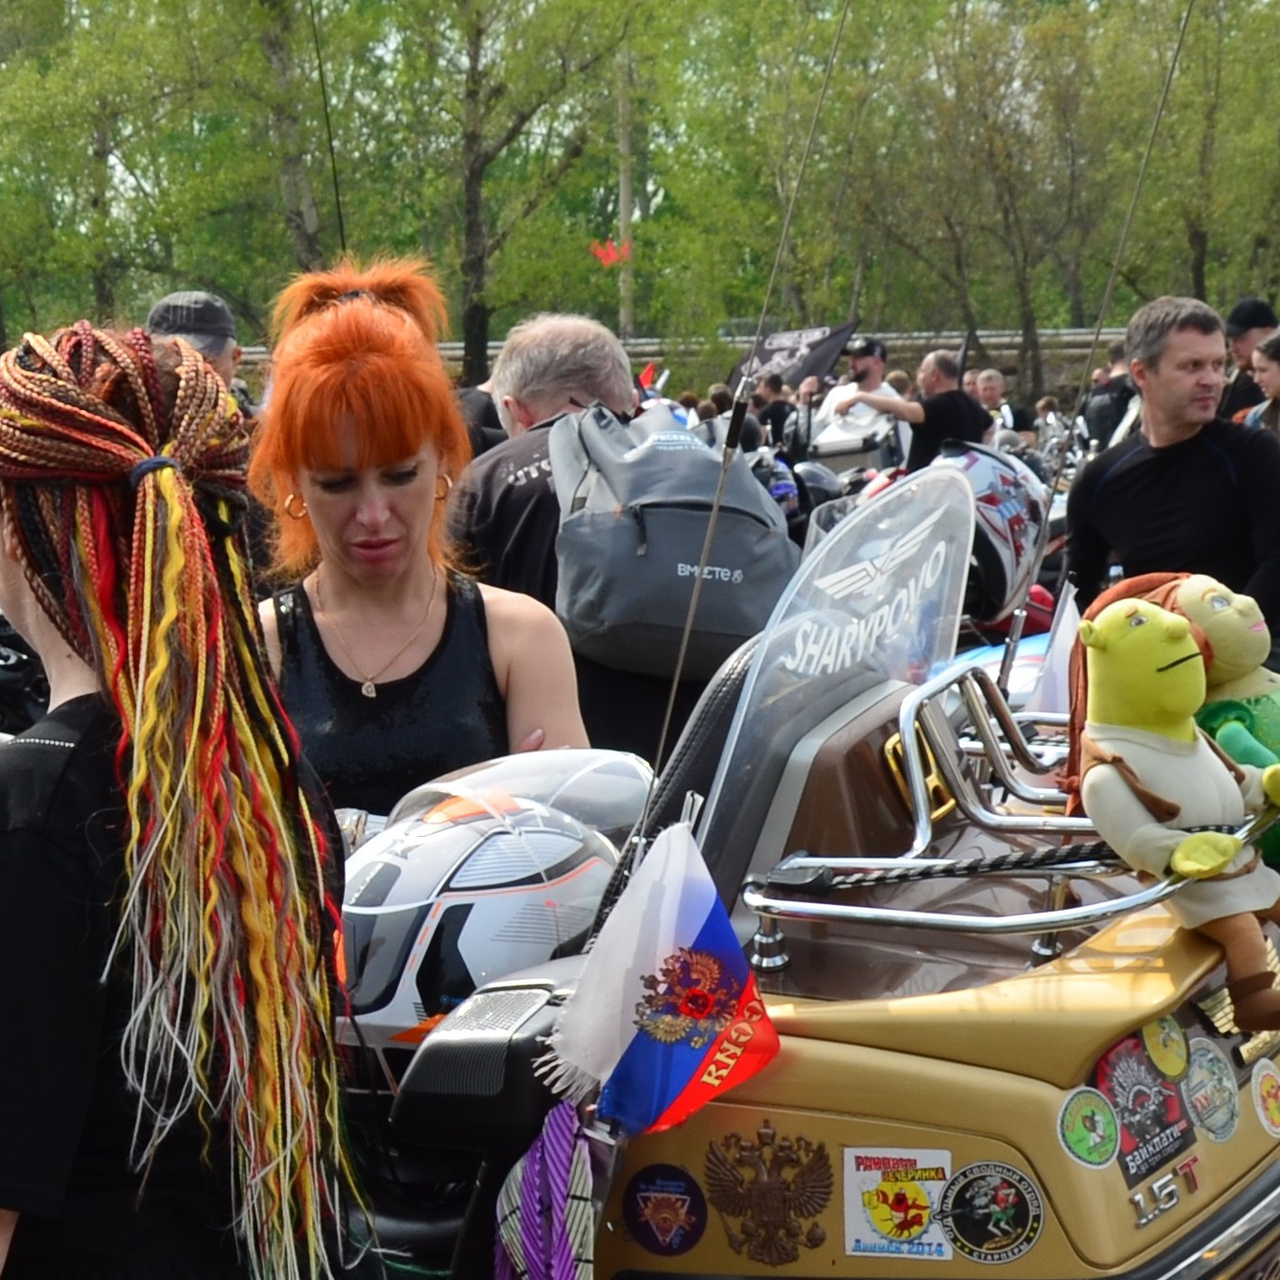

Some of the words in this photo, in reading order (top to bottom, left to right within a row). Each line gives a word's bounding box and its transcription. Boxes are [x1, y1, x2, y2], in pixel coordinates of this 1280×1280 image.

[784, 540, 946, 676] SHARYPOVO
[881, 1167, 947, 1182] ВЕЧЕРИНКА
[942, 1174, 965, 1240] ОТДЛЬНЫЙ
[966, 1164, 1021, 1181] СВОДНЫЙ
